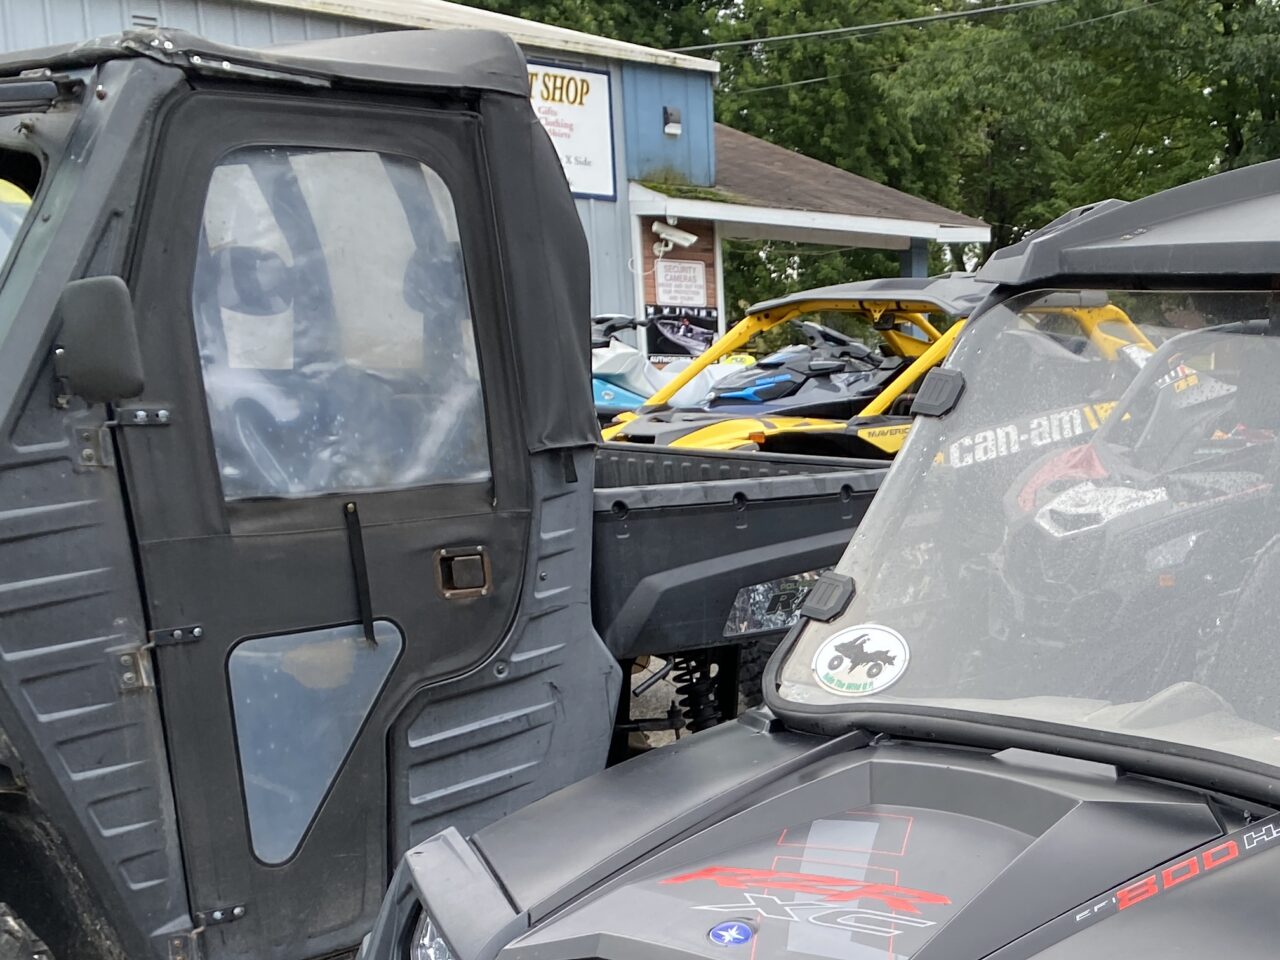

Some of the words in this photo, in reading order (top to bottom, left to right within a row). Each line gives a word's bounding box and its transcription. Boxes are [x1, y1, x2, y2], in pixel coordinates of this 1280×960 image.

[540, 73, 590, 106] SHOP
[663, 264, 697, 274] SECURITY
[664, 273, 697, 283] CAMERAS
[948, 405, 1084, 469] can-am
[658, 865, 952, 914] RZR
[1116, 840, 1239, 911] 800
[689, 892, 938, 937] XC
